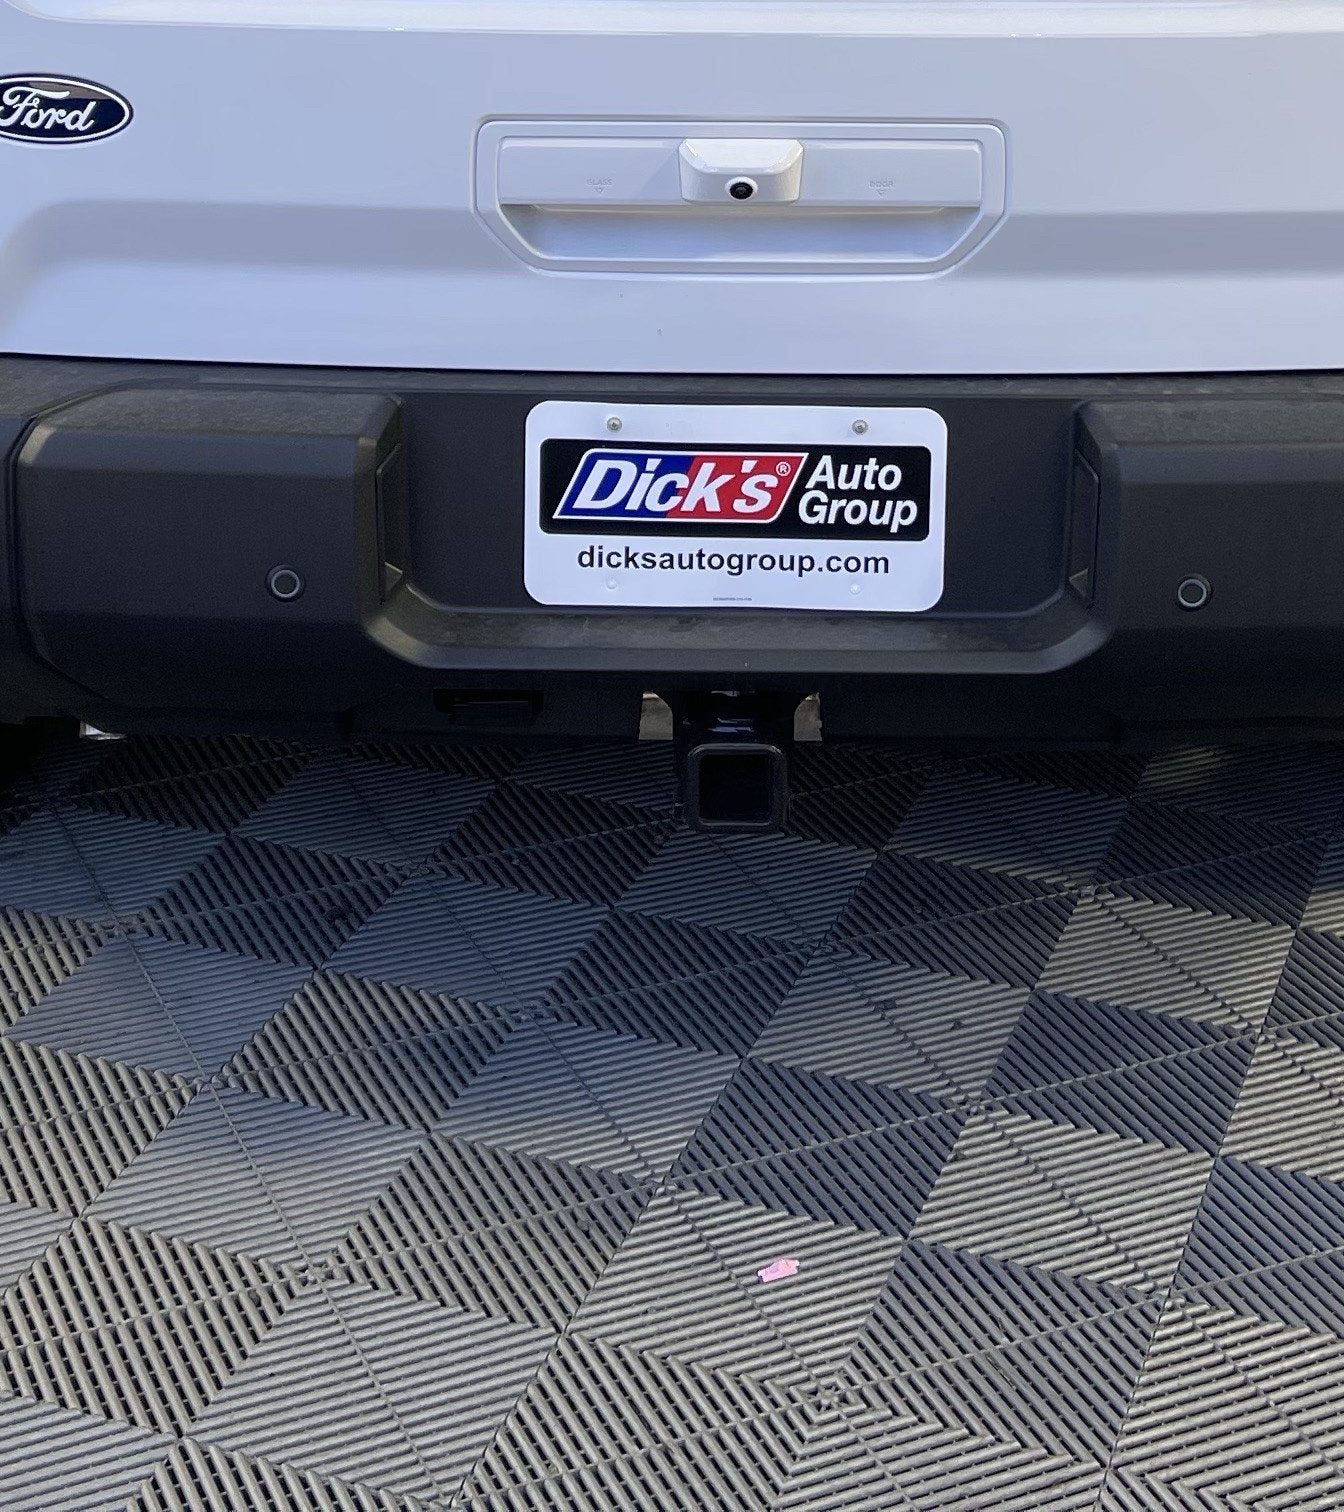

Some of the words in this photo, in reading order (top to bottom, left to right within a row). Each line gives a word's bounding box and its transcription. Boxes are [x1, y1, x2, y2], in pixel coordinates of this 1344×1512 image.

[806, 455, 902, 490] Auto
[799, 491, 918, 533] Group
[577, 545, 890, 577] dicksautogroup.com
